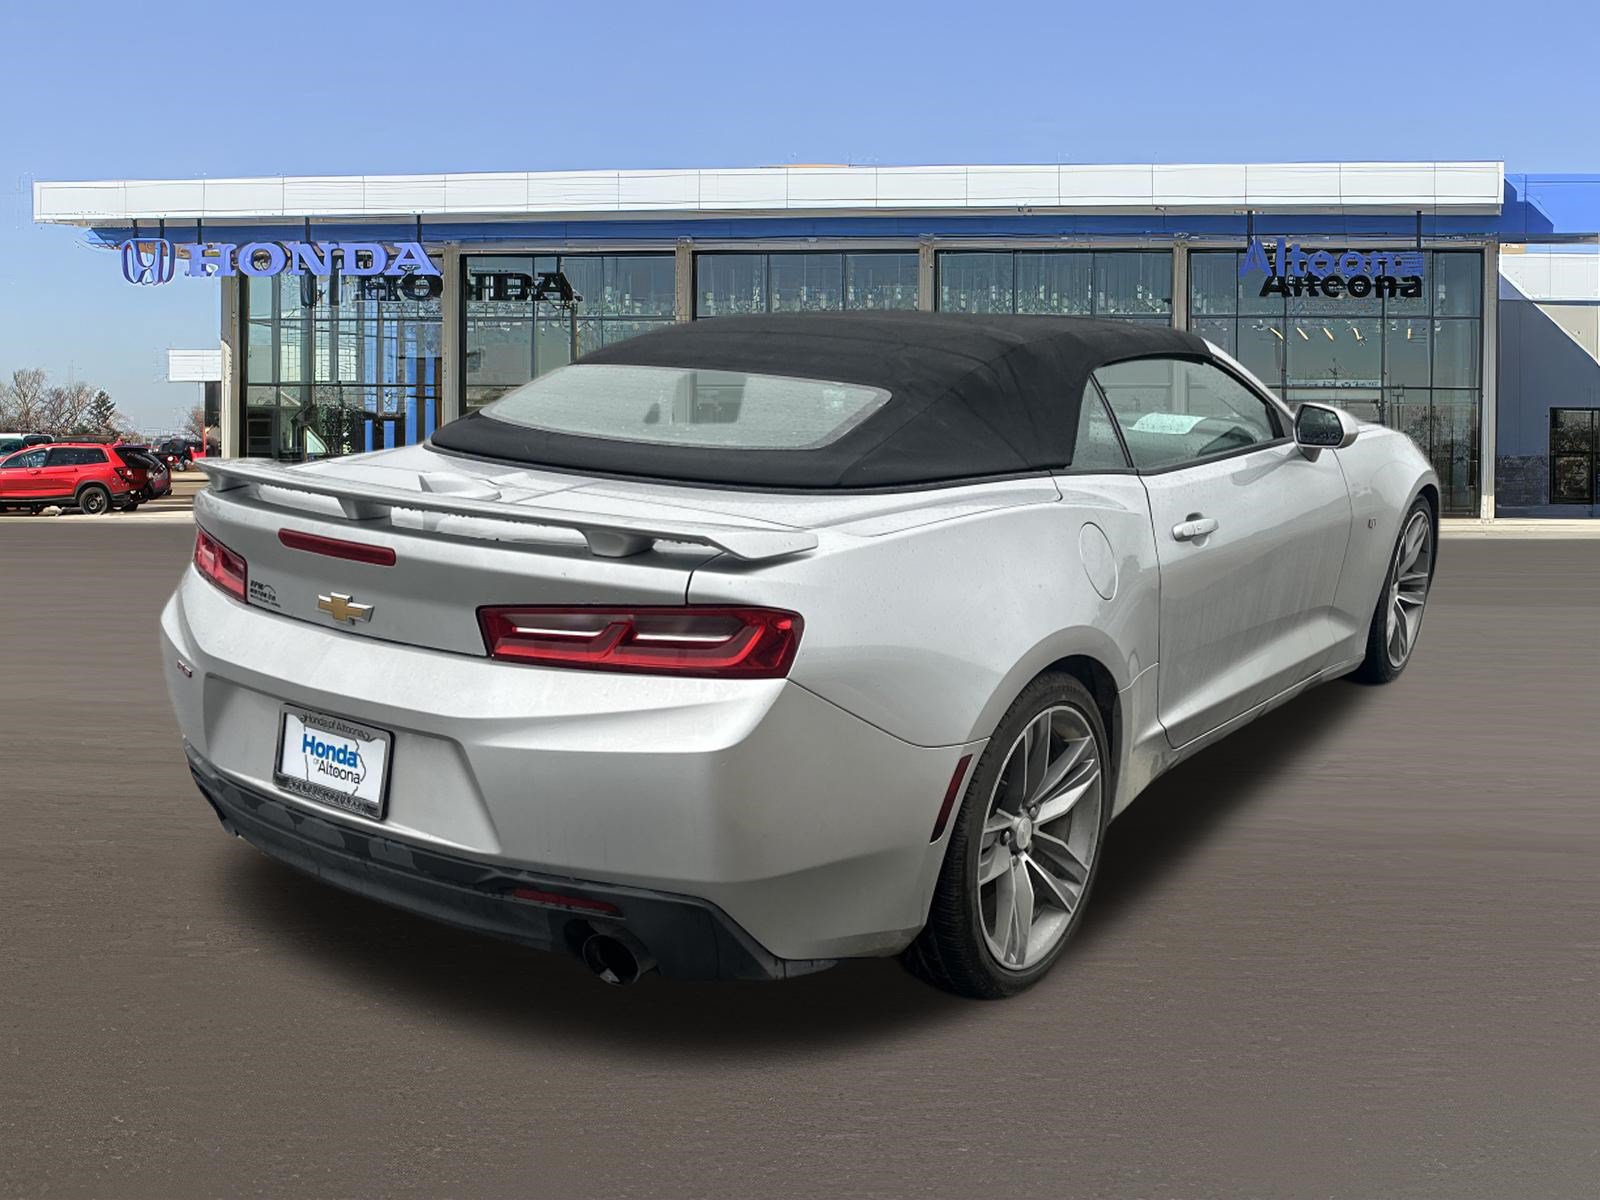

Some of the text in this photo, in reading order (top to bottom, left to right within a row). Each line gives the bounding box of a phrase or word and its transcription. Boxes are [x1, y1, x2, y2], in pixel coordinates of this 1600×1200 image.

[184, 241, 441, 277] HONDA
[302, 734, 358, 768] Honda
[318, 760, 361, 785] Altoona
